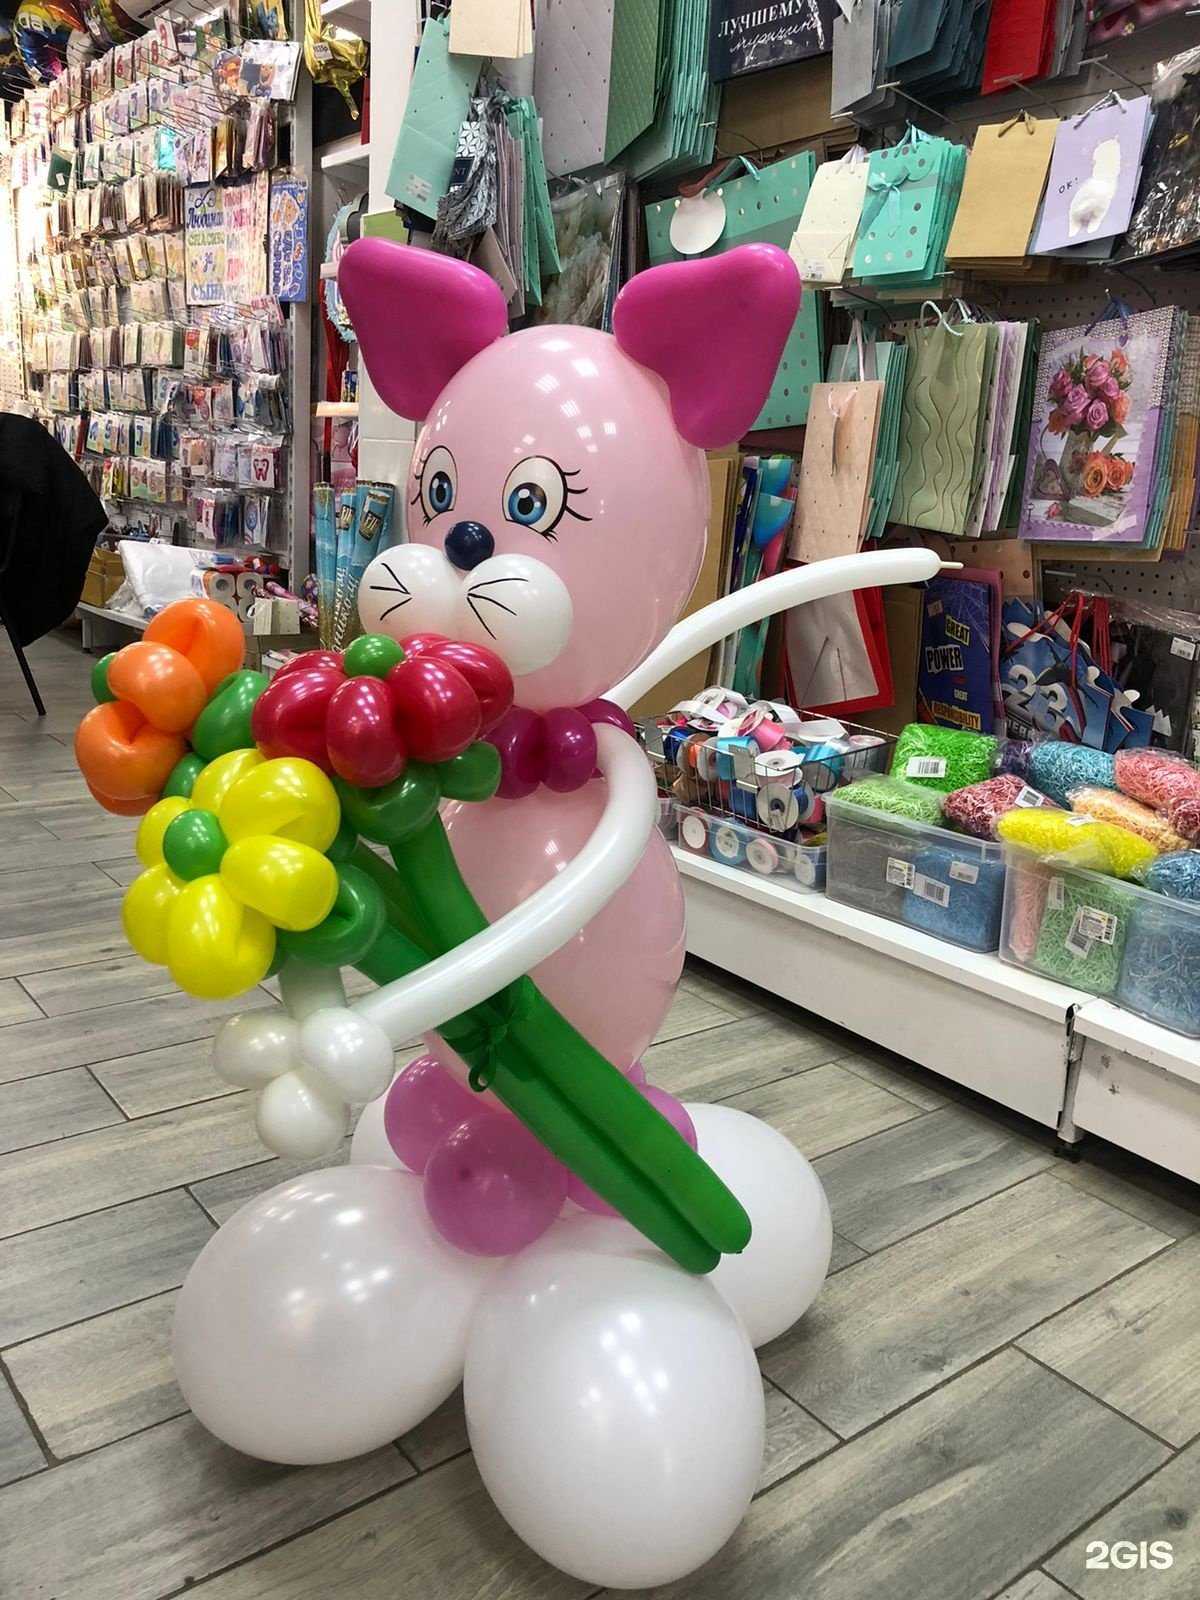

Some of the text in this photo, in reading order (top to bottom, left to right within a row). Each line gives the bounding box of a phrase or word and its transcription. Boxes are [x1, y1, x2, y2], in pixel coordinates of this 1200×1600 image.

[718, 0, 803, 37] ЛУЧШЕМУ
[945, 616, 970, 645] GREAT
[926, 646, 963, 672] POWER
